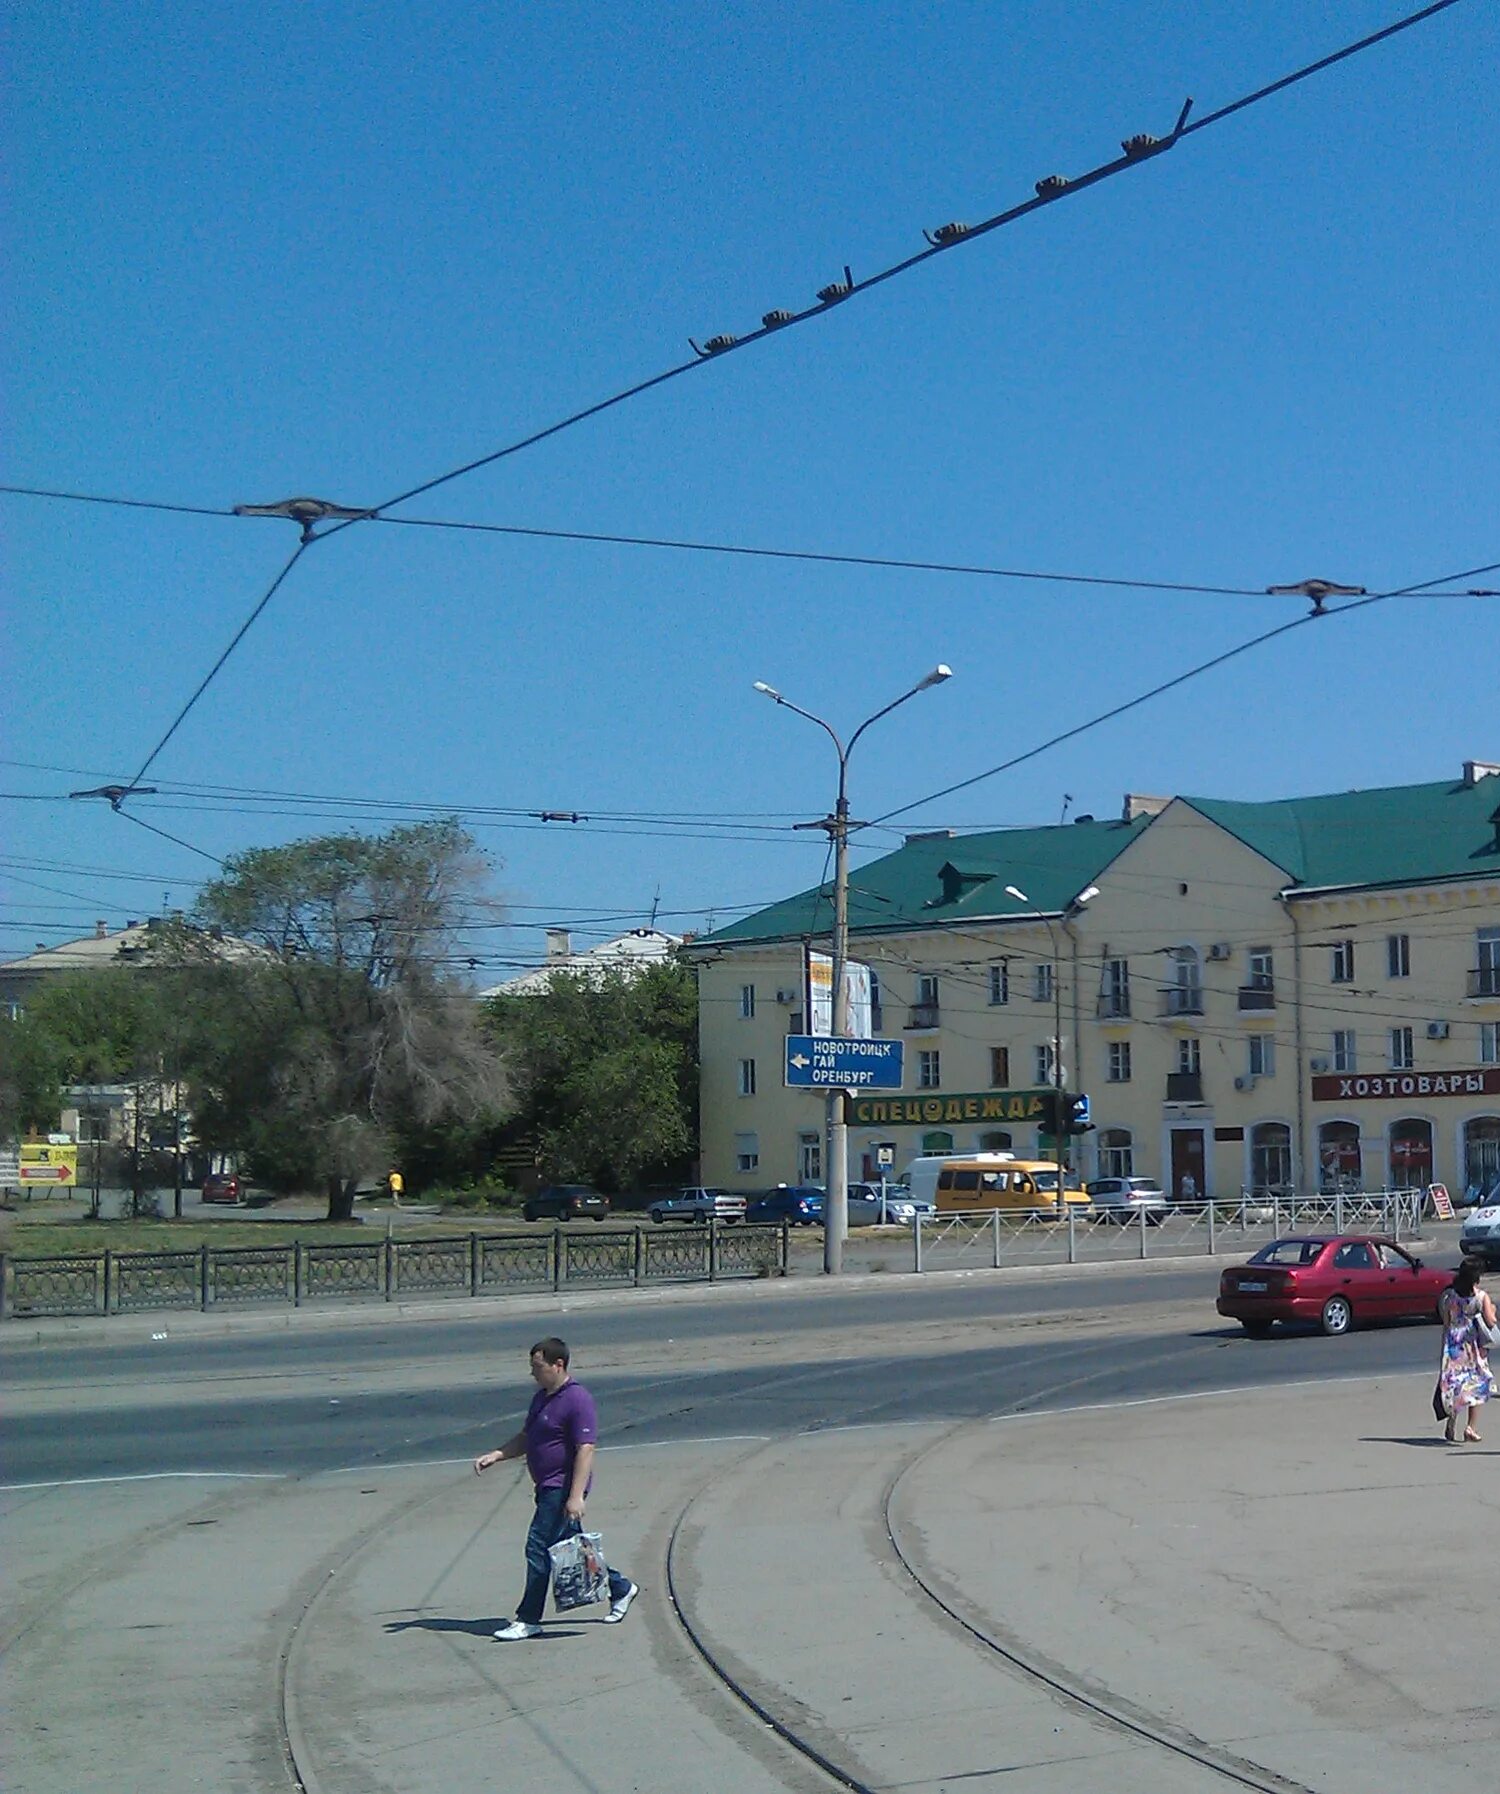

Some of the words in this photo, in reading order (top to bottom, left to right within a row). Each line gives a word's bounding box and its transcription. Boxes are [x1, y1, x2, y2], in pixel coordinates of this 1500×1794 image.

[813, 1041, 891, 1057] НОВОТРОИЦК
[813, 1055, 836, 1068] ГАЙ
[812, 1070, 874, 1083] ОРЕНБУРГ
[1340, 1074, 1483, 1096] ХОЗТОВАРЫ
